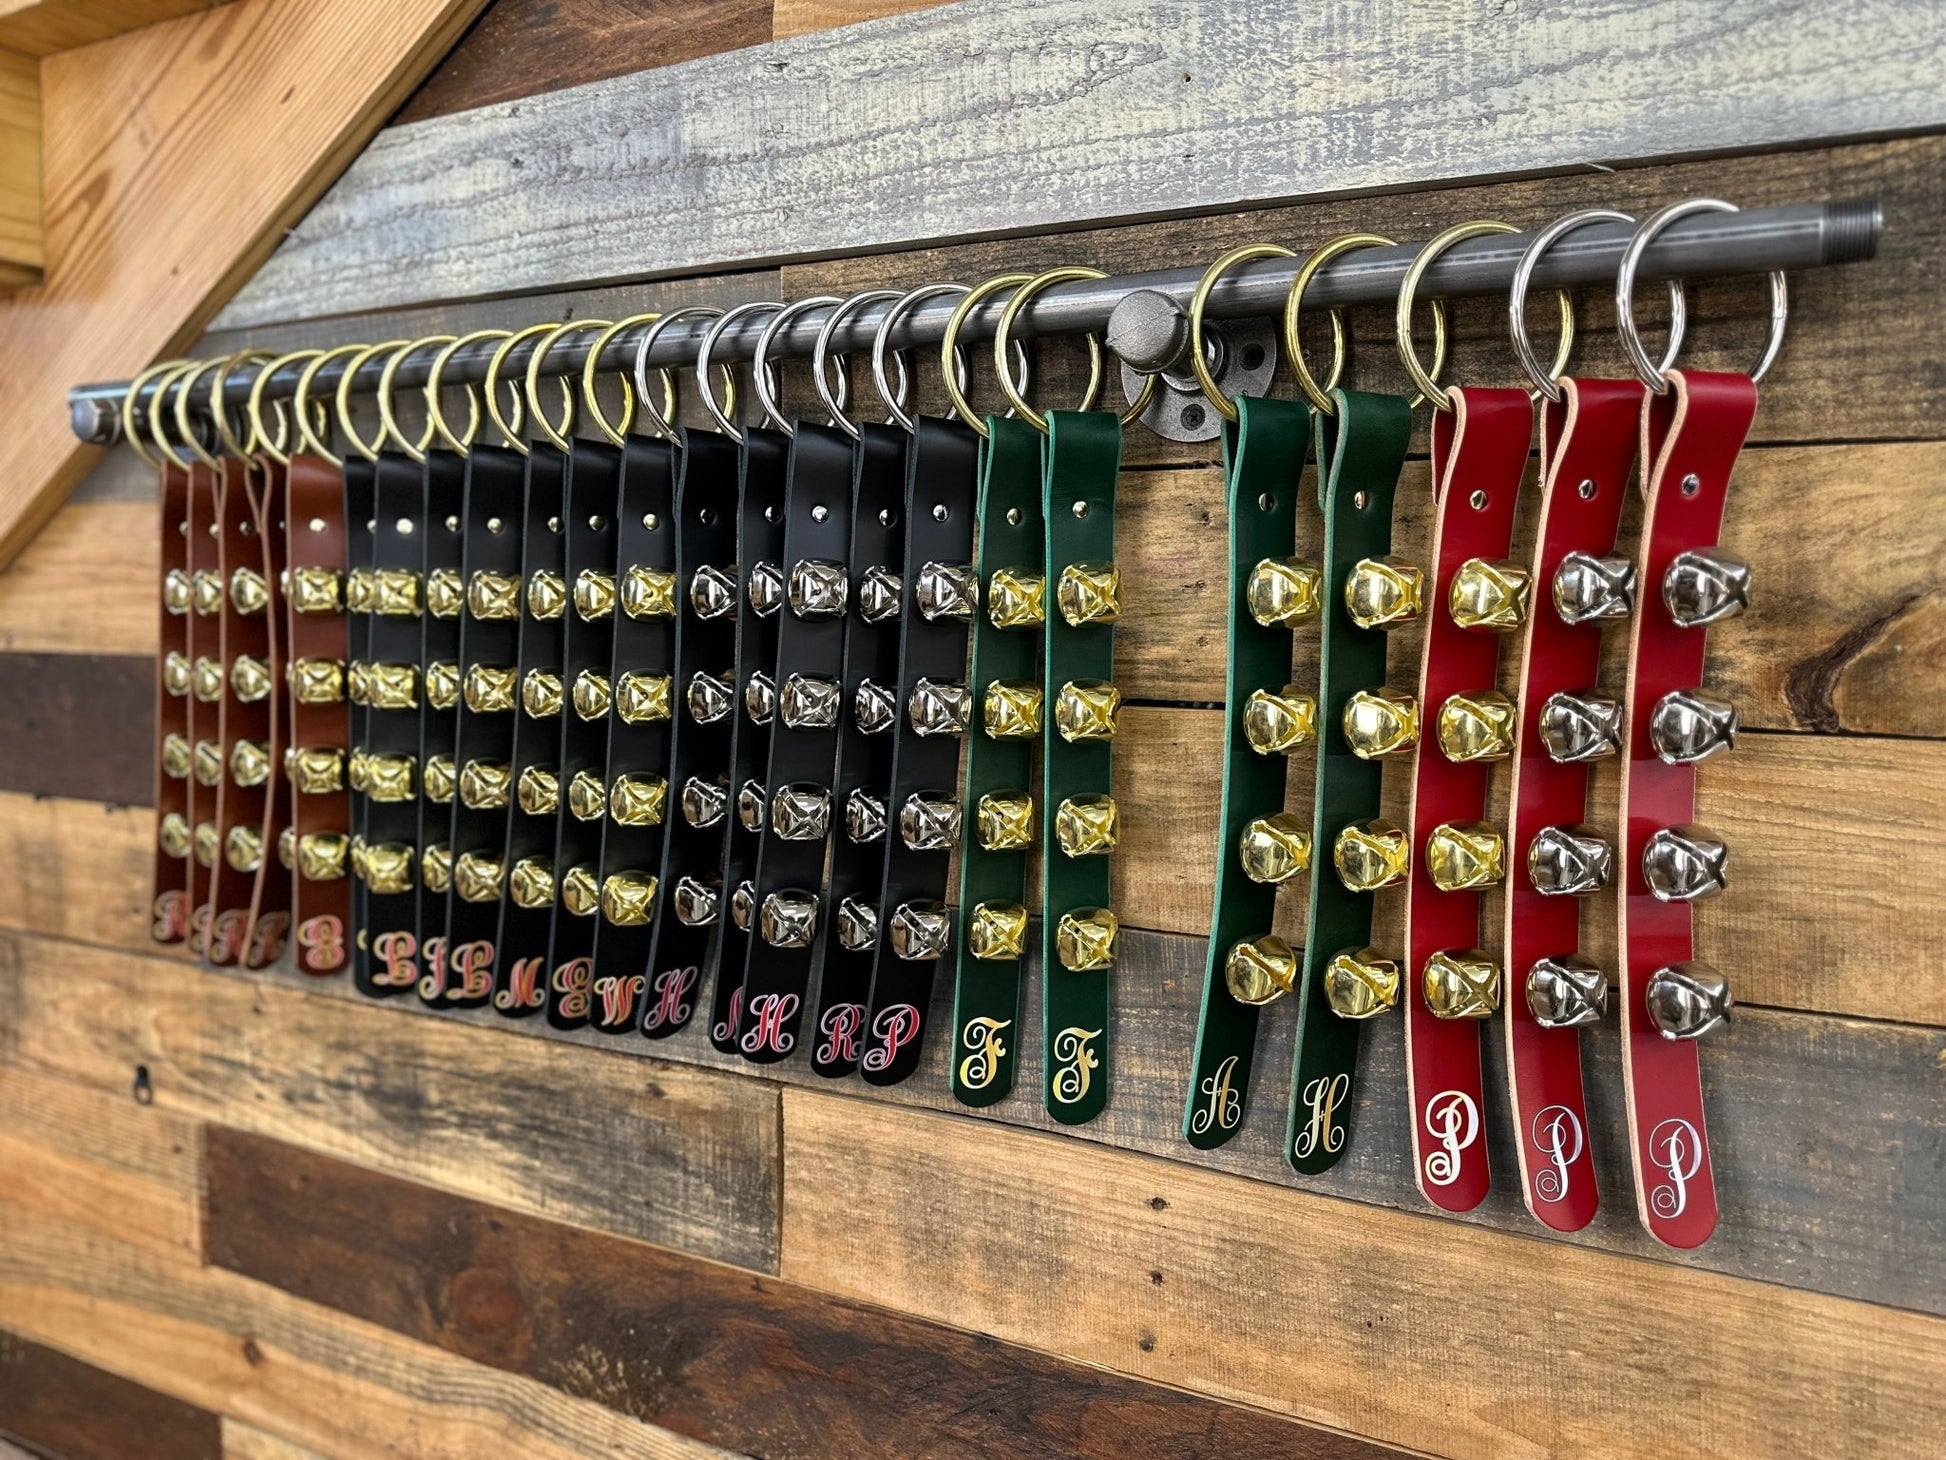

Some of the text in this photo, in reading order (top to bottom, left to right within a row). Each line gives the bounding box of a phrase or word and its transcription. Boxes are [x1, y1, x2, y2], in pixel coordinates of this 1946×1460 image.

[494, 957, 545, 1009] M
[594, 975, 645, 1026] W
[644, 966, 698, 1030] H
[741, 993, 799, 1053] H
[816, 1003, 867, 1064] R
[863, 1004, 920, 1071] P
[959, 1016, 1012, 1090] F
[1052, 1027, 1102, 1103] F
[1192, 1055, 1241, 1134] A
[1295, 1073, 1349, 1159] H
[1425, 1090, 1479, 1186] P
[1532, 1105, 1583, 1203] P
[1648, 1118, 1702, 1219] P
